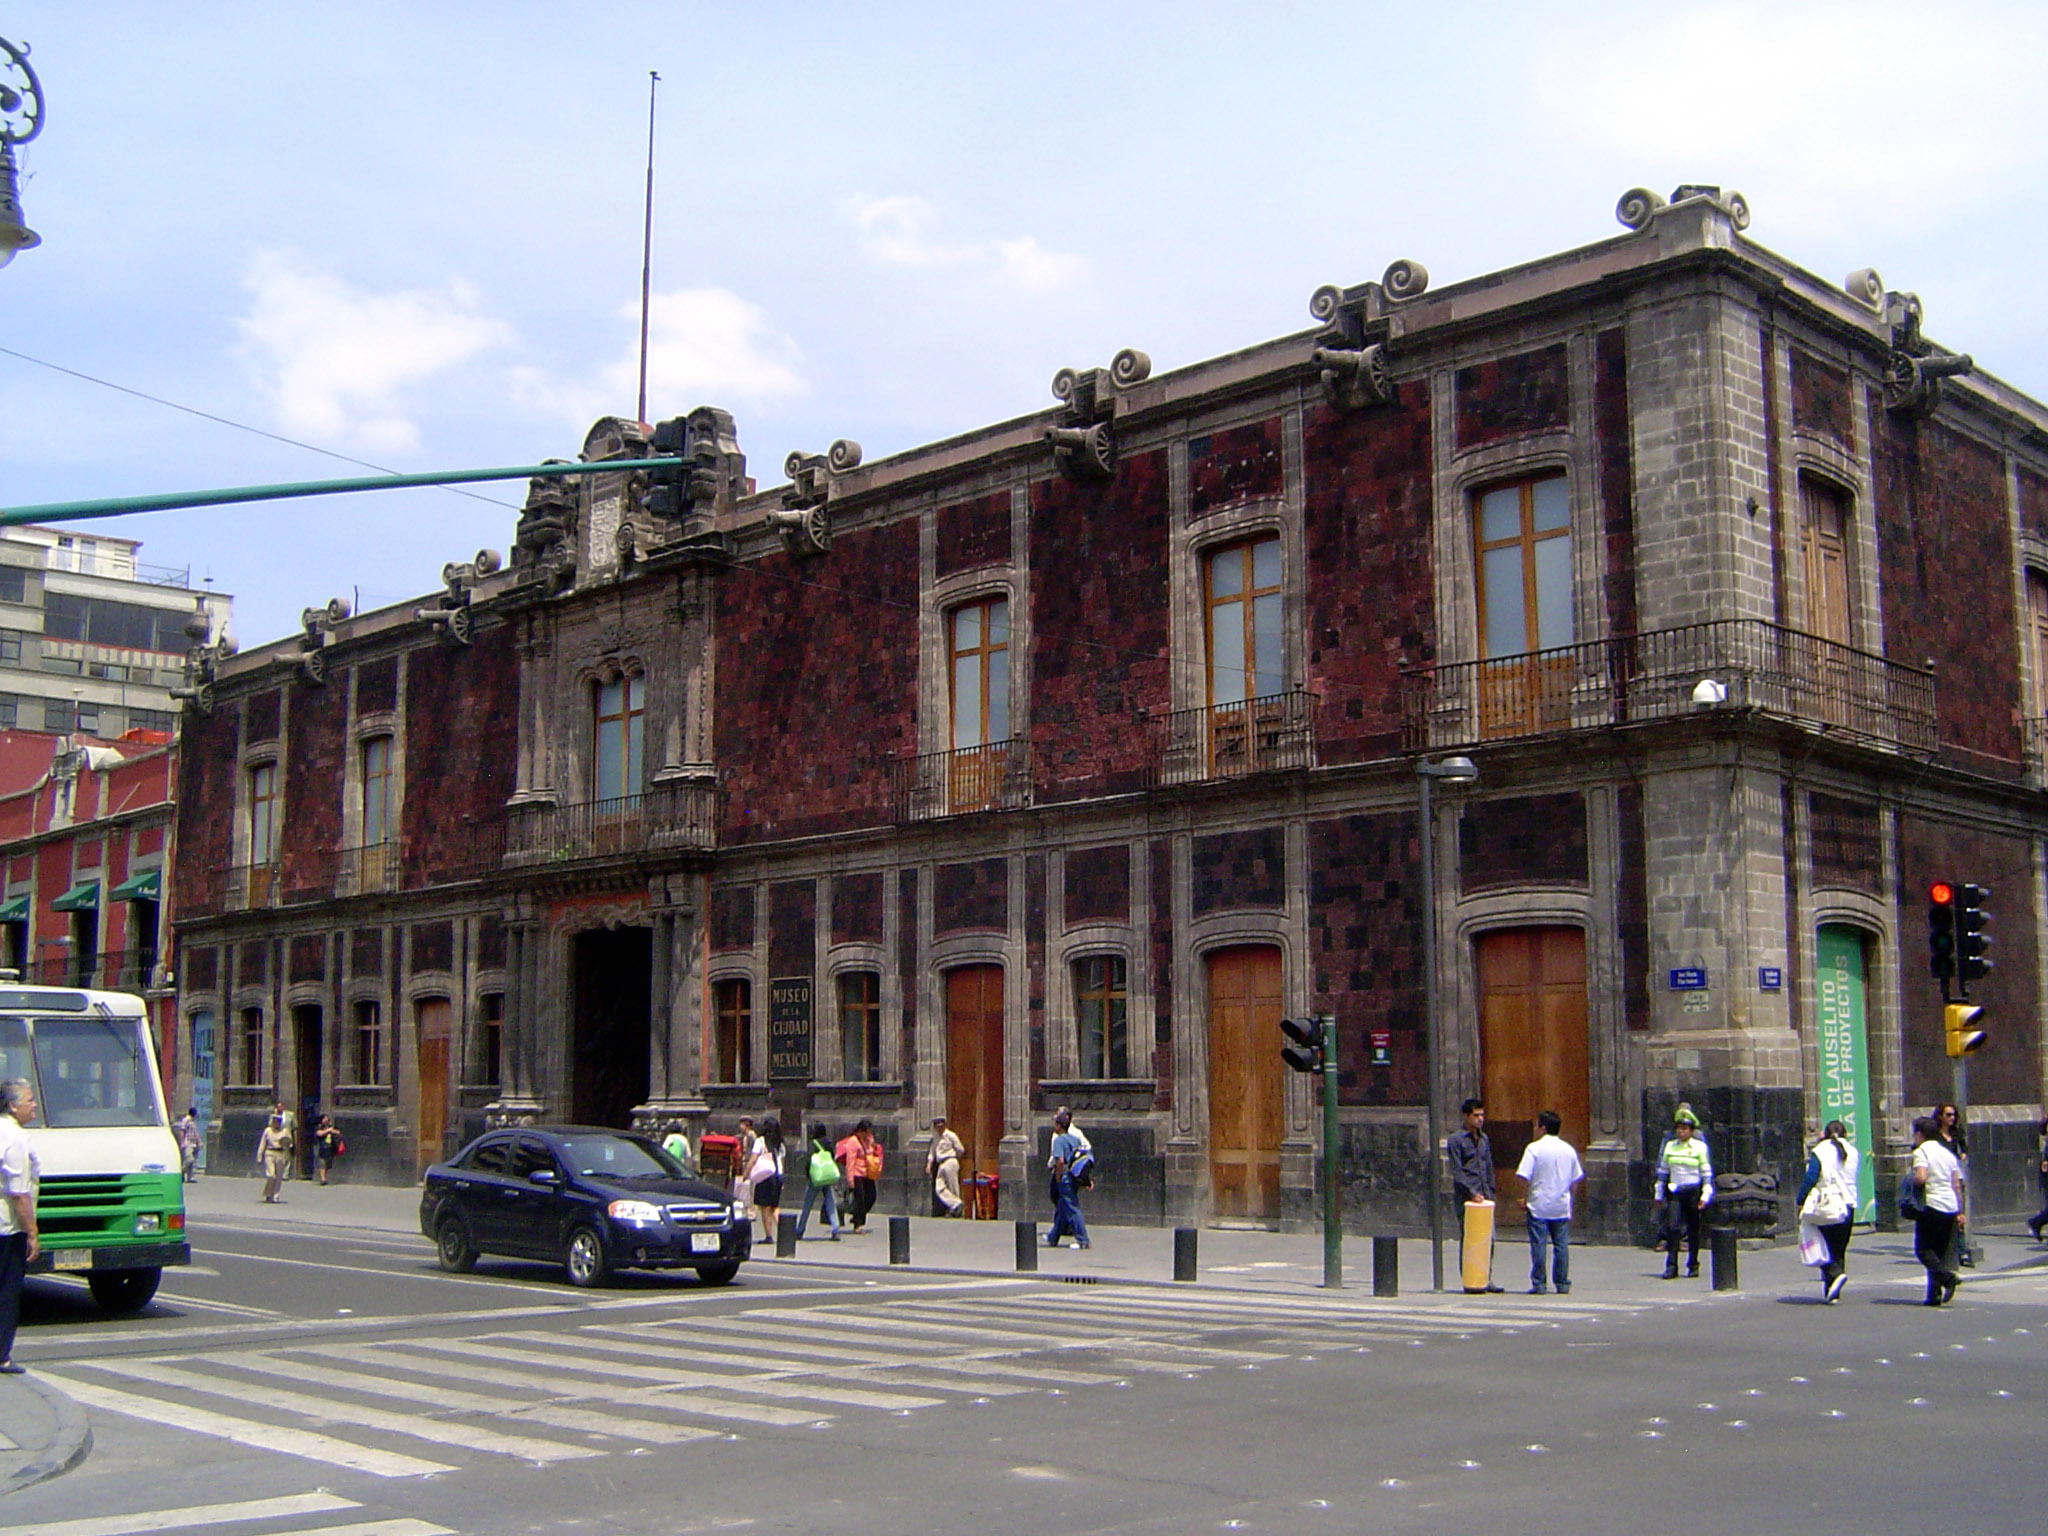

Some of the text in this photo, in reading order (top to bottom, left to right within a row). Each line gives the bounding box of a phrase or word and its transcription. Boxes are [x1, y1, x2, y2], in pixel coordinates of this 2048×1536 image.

[773, 988, 808, 1003] MUSEO
[1836, 955, 1854, 1073] PROYECTOS
[773, 1020, 808, 1036] CIUDAD
[1822, 980, 1841, 1107] CLAUSELITO
[1842, 1079, 1855, 1106] DE
